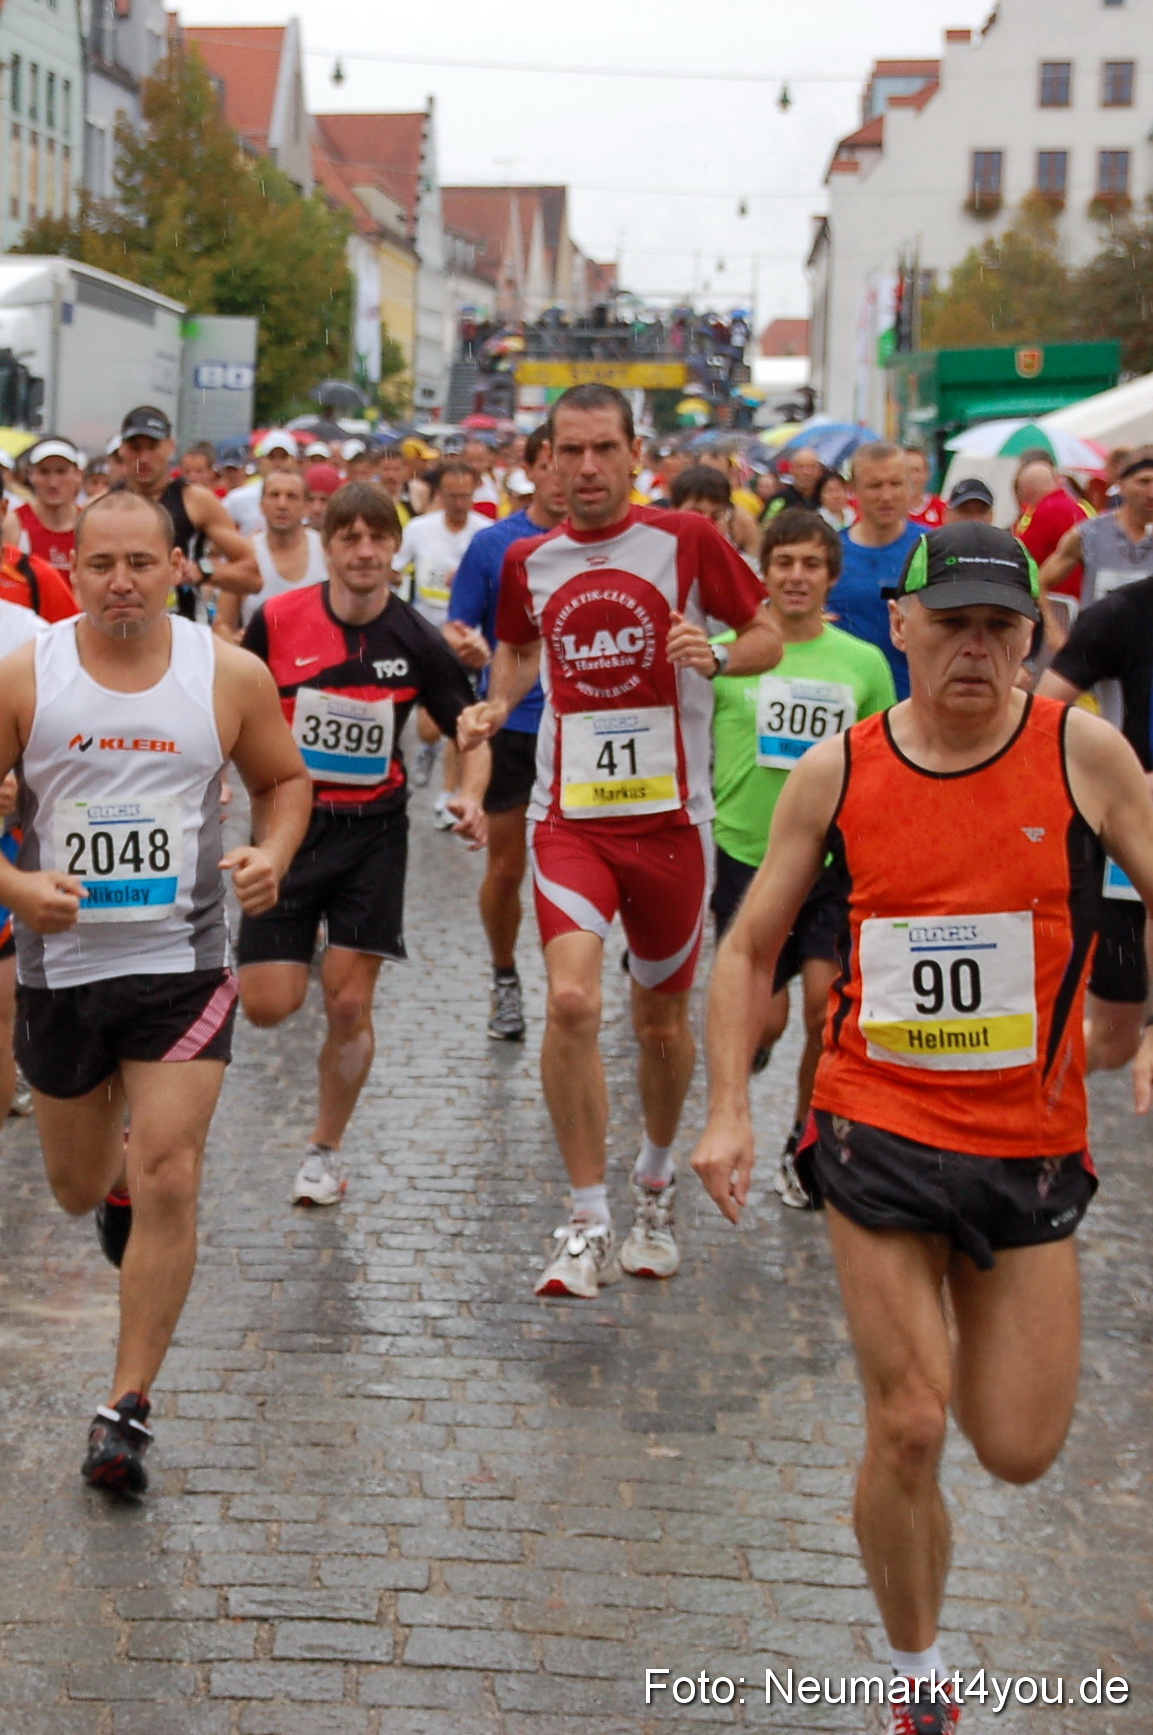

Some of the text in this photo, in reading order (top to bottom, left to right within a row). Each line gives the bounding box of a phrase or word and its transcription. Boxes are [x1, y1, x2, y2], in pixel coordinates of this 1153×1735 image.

[561, 626, 646, 661] LAC
[767, 701, 845, 738] 3061
[99, 737, 182, 755] KLEBL
[302, 715, 385, 754] 3399
[596, 738, 638, 777] 41
[592, 787, 647, 802] Markus
[87, 803, 141, 819] BOCK
[65, 828, 171, 876] 2048
[88, 887, 150, 905] Nikolay
[909, 925, 978, 943] BOCK
[912, 957, 983, 1015] 90
[908, 1026, 989, 1049] Helmut
